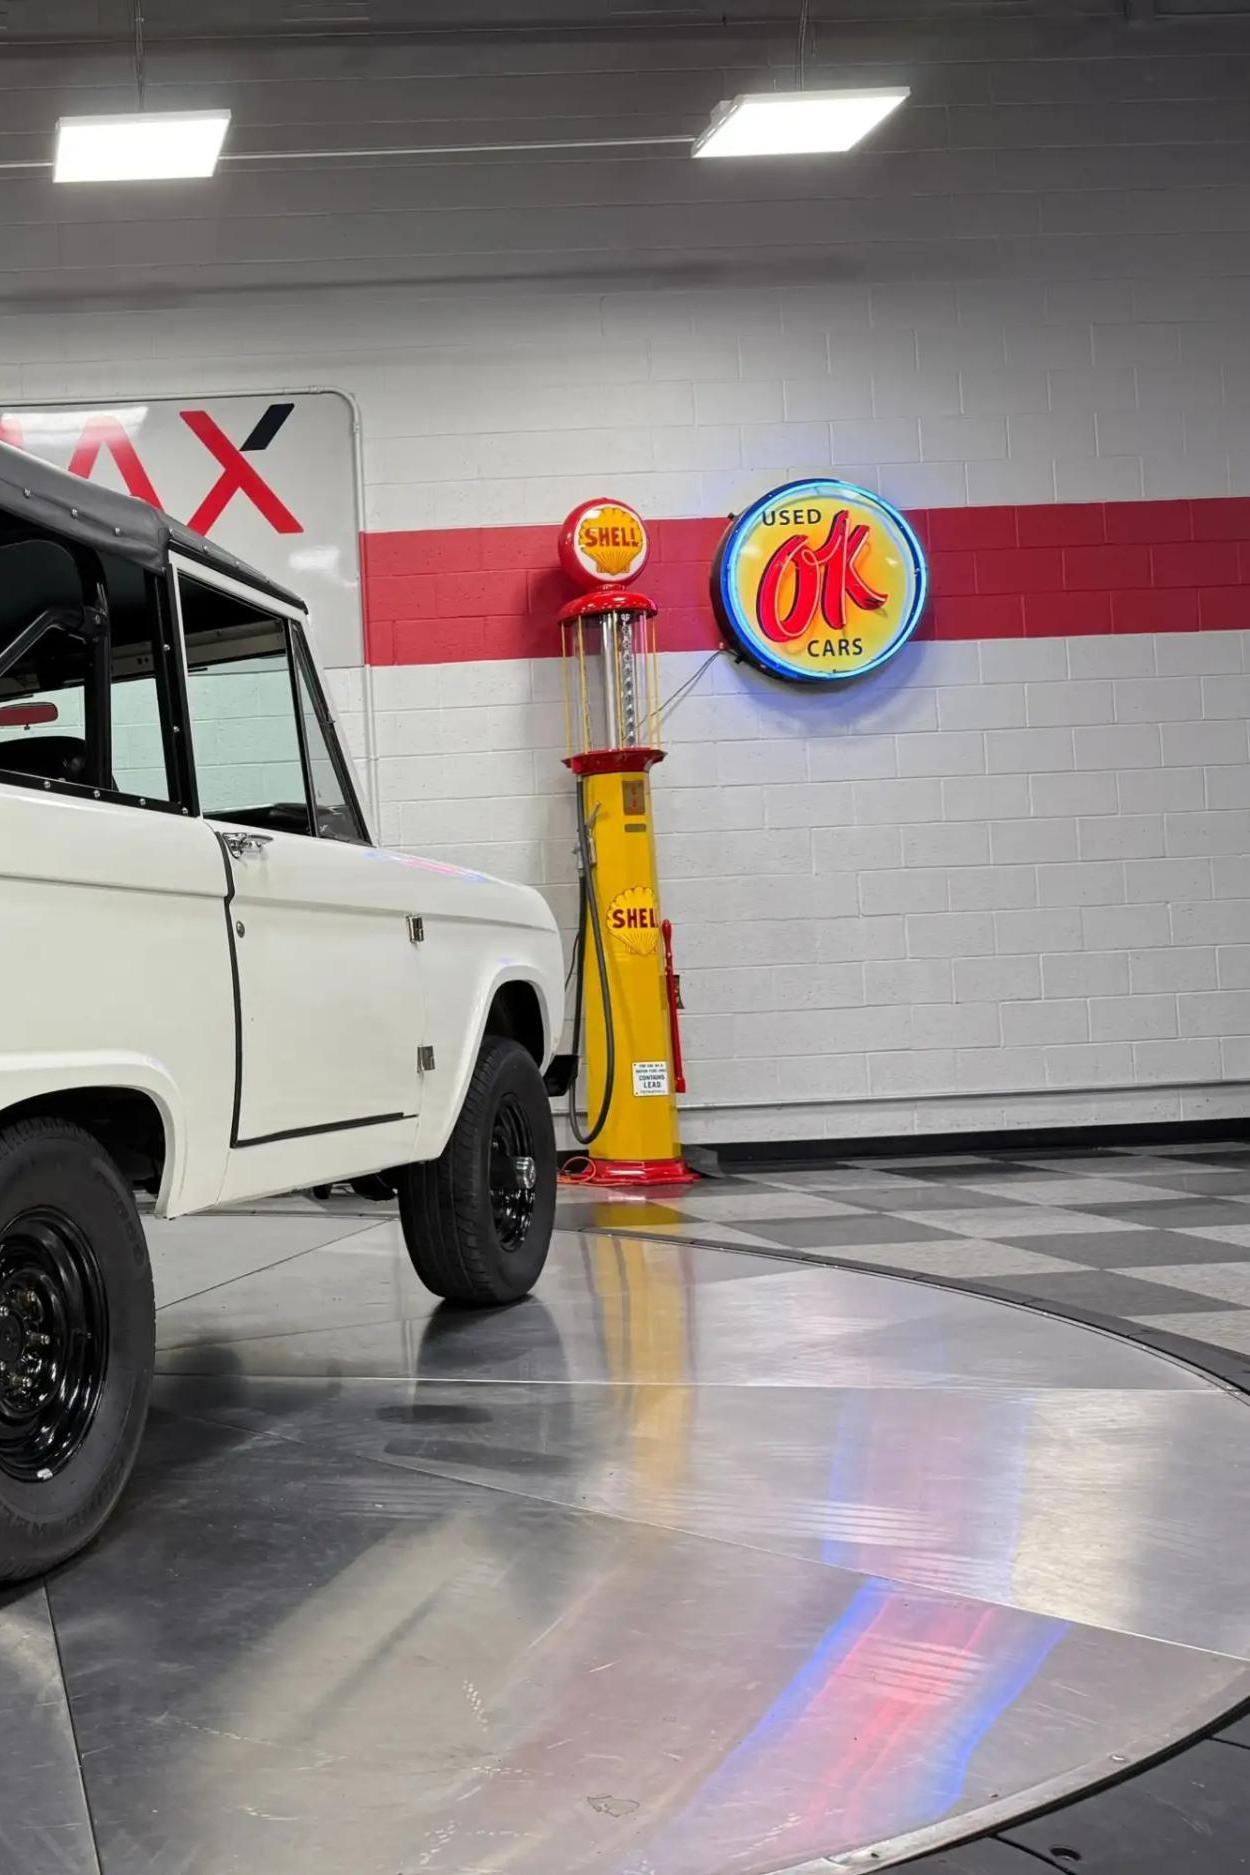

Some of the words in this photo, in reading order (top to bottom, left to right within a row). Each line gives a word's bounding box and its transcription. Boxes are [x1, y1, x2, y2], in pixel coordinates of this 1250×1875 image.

[761, 509, 822, 526] USED
[584, 526, 639, 548] SHELL
[756, 510, 888, 643] OK
[807, 638, 863, 657] CARS
[643, 1081, 661, 1089] LEAD
